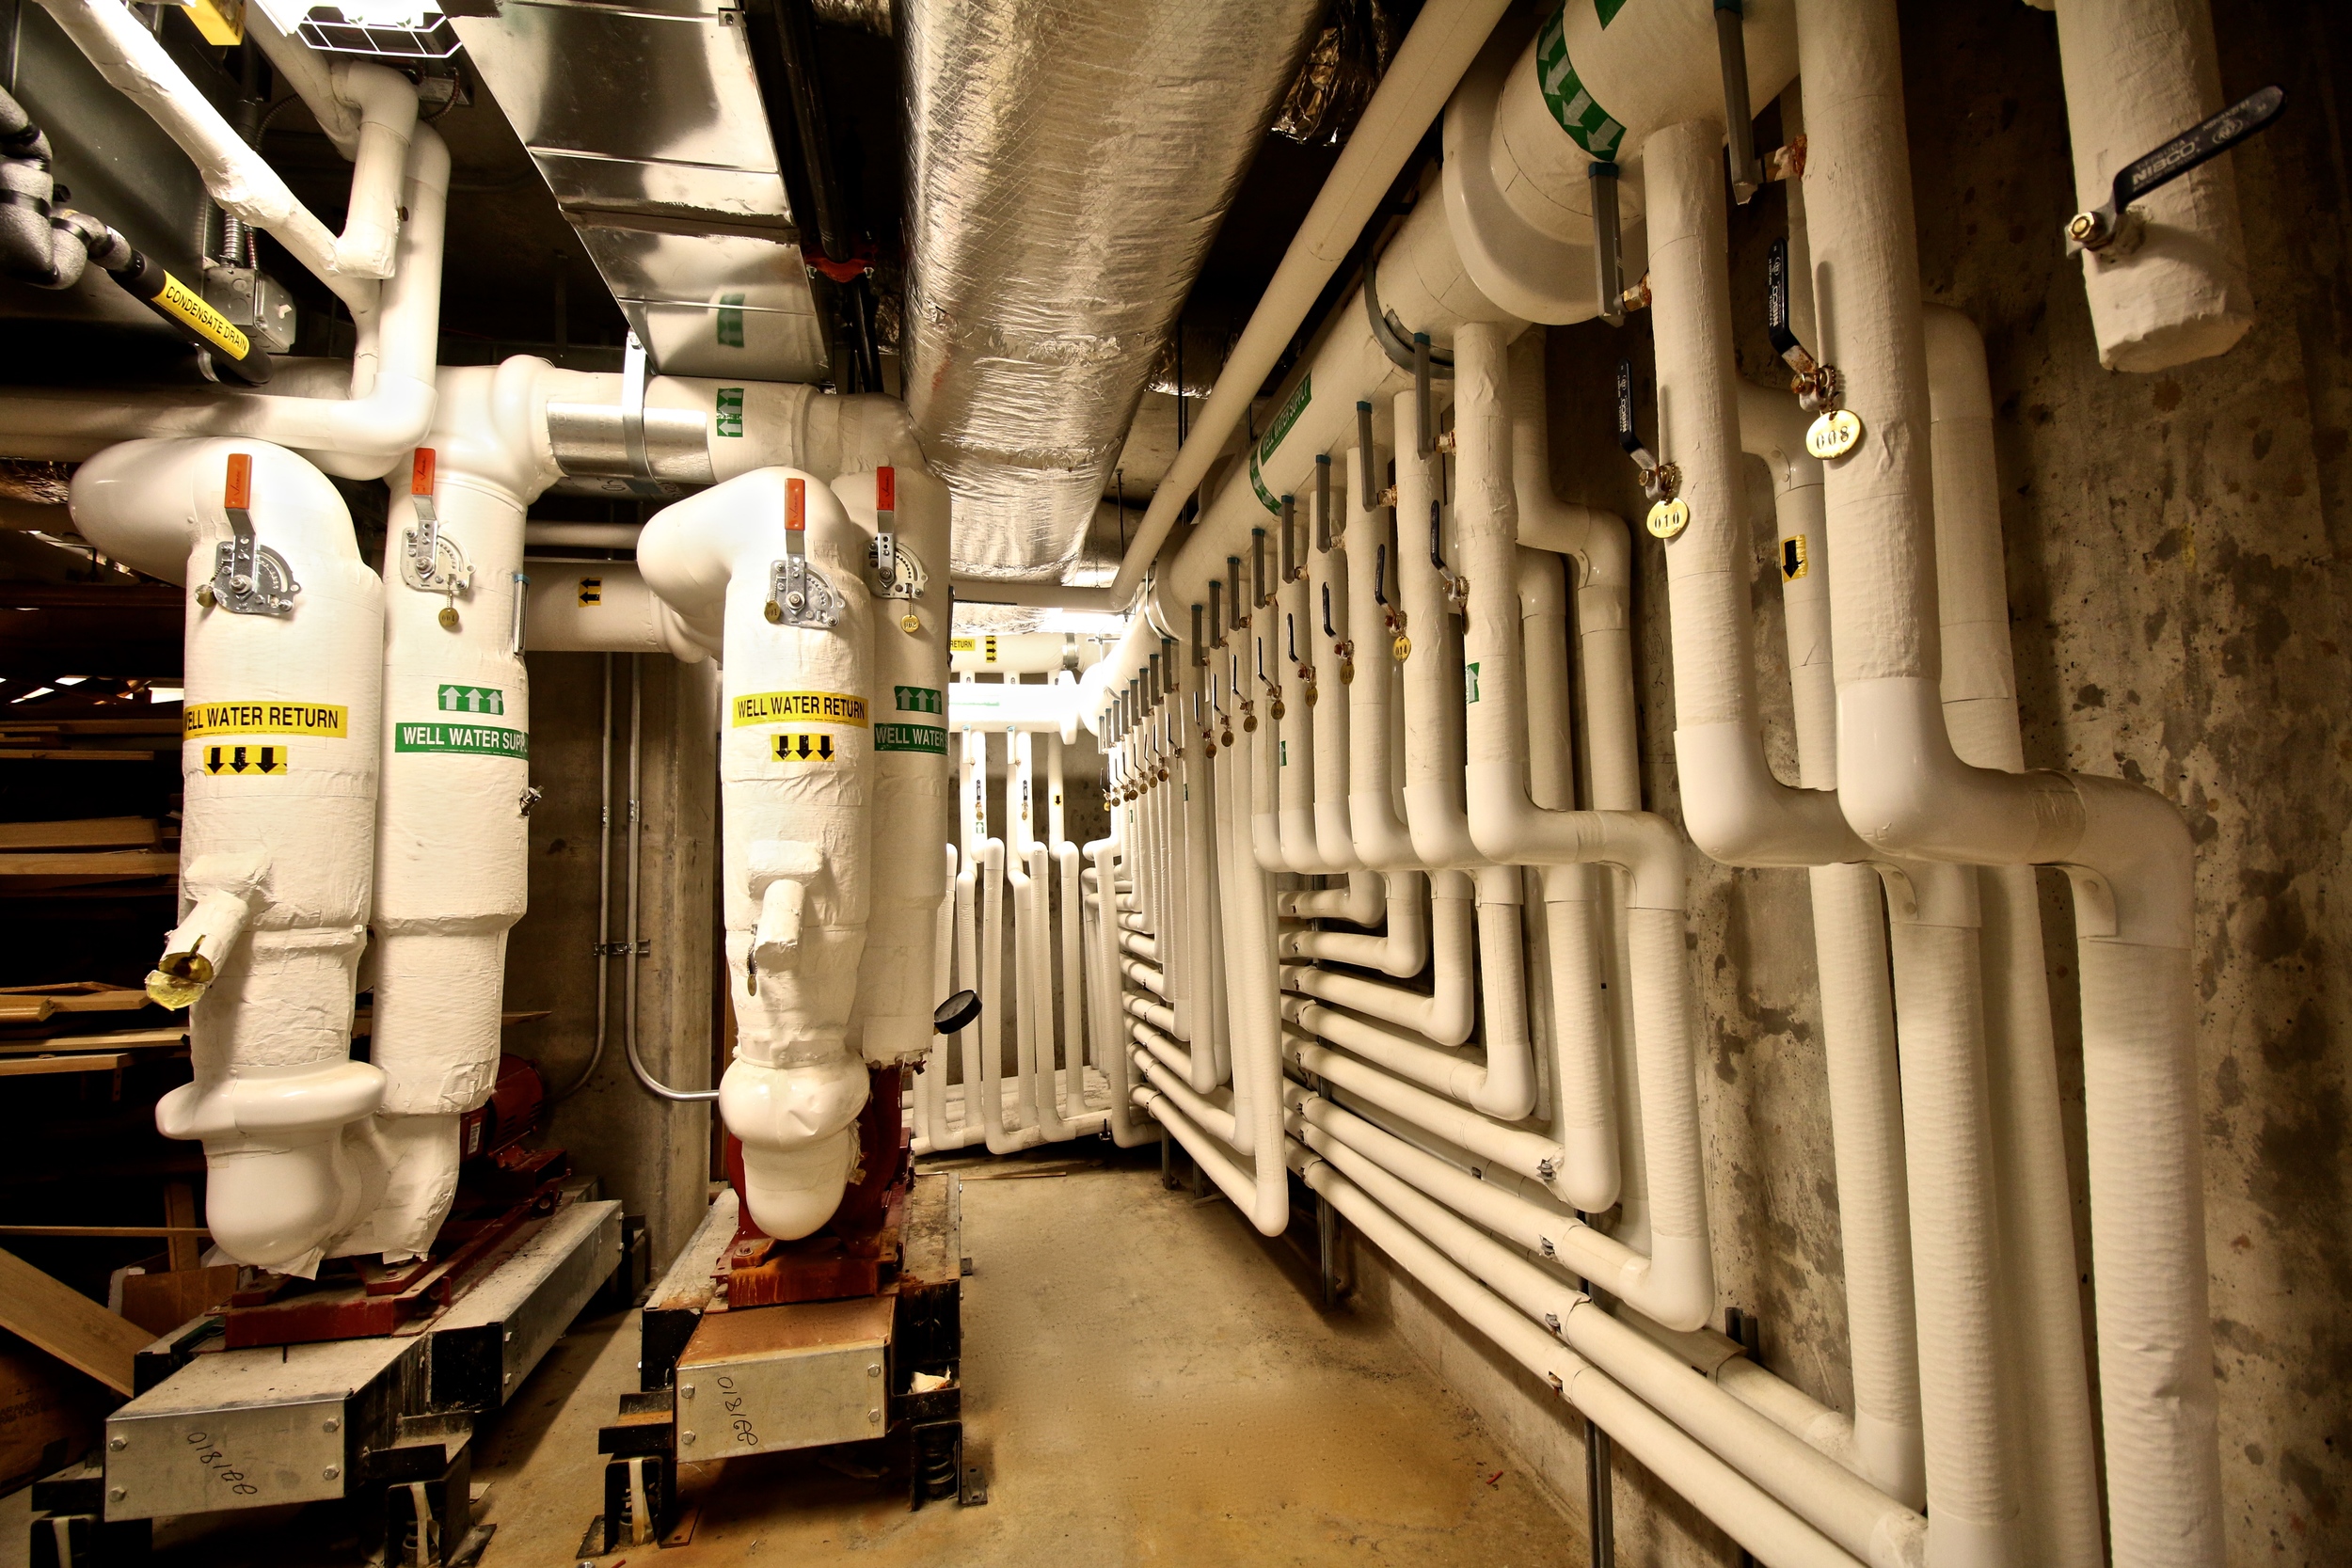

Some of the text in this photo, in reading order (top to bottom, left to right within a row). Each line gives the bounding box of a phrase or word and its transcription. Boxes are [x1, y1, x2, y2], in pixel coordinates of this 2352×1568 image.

[2132, 141, 2196, 185] NIBCO
[166, 286, 247, 351] CONDENSATE DRAIN
[1816, 425, 1850, 451] 008
[1654, 511, 1680, 529] 010
[949, 640, 973, 648] RETURN
[1395, 645, 1407, 656] 014
[207, 705, 263, 727] WATER
[269, 706, 339, 729] RETURN
[738, 695, 865, 720] WELL WATER RETURN
[403, 726, 444, 745] WELL
[449, 728, 500, 749] WATER
[875, 726, 910, 745] WELL
[913, 728, 945, 748] WATER
